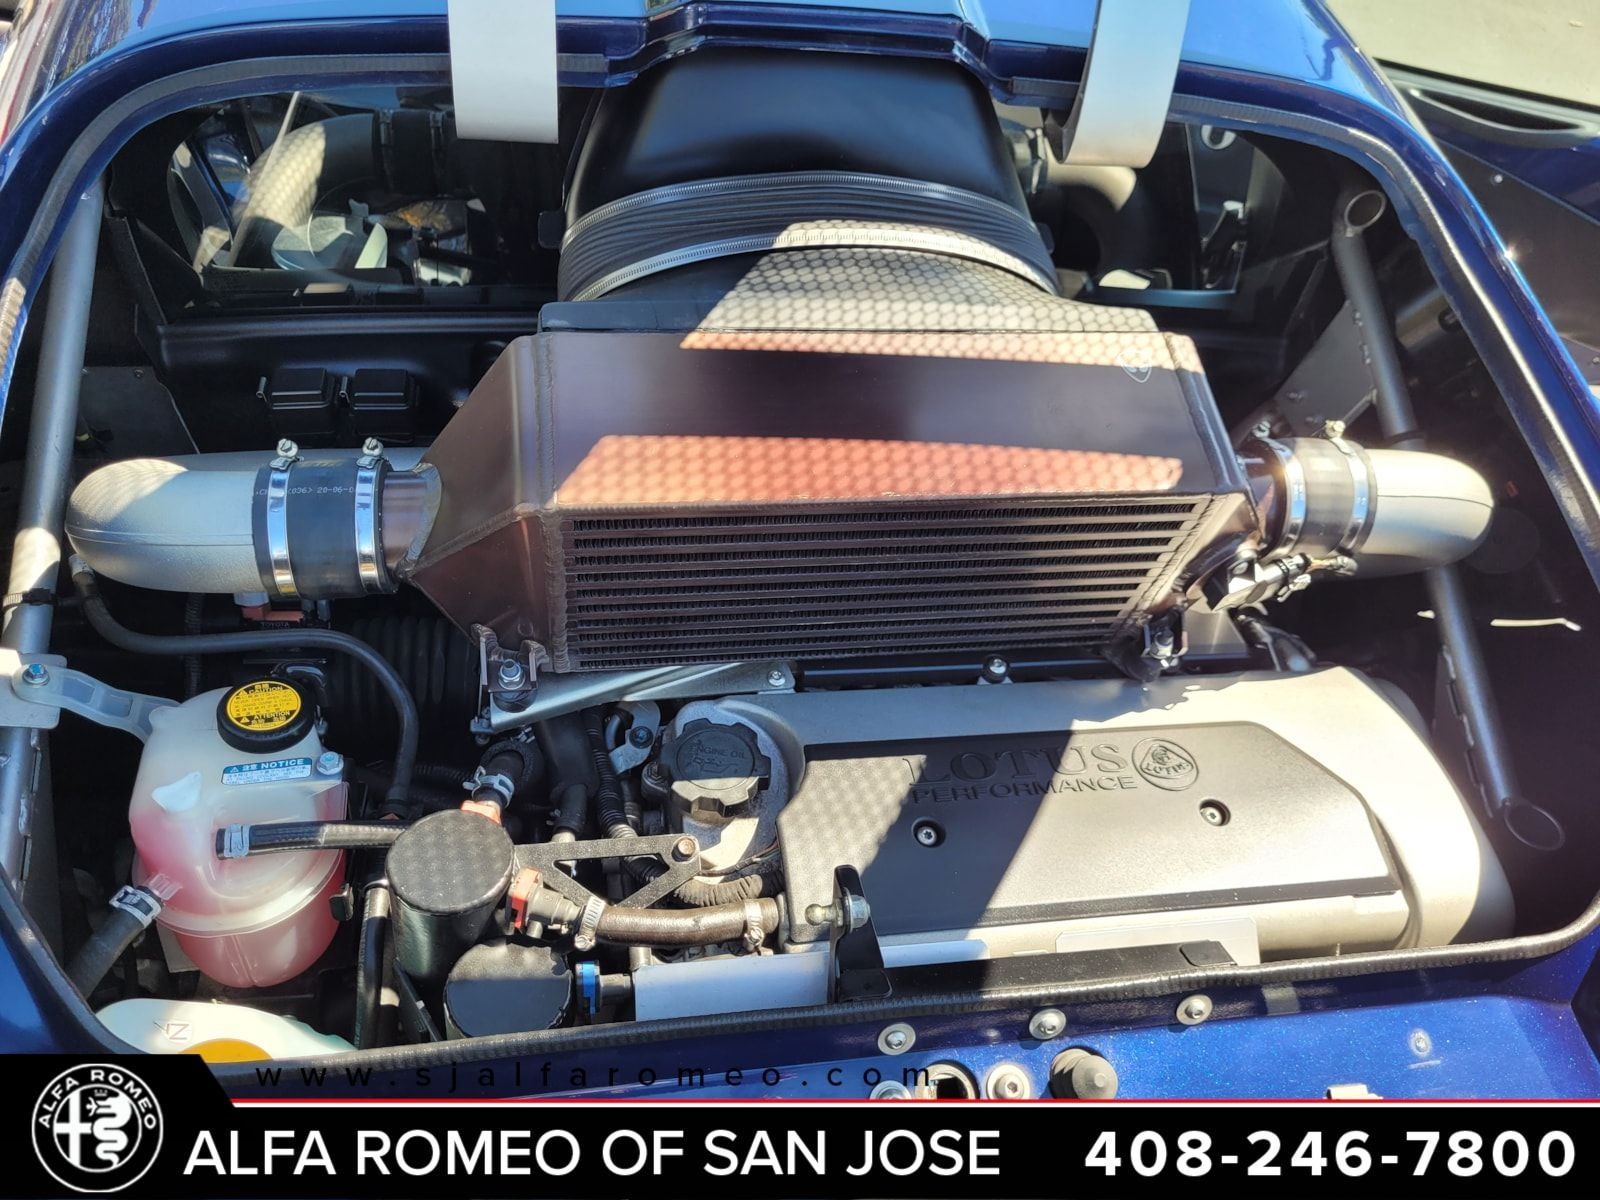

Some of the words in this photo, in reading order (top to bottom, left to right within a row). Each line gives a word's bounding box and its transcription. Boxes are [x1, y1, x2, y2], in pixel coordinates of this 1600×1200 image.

[248, 684, 283, 695] CAUTION
[252, 710, 291, 720] ATTENTION
[691, 743, 728, 757] NGINE
[260, 758, 305, 770] NOTICE
[902, 742, 1129, 786] LOTUS
[910, 775, 1139, 804] PERFORMANCE
